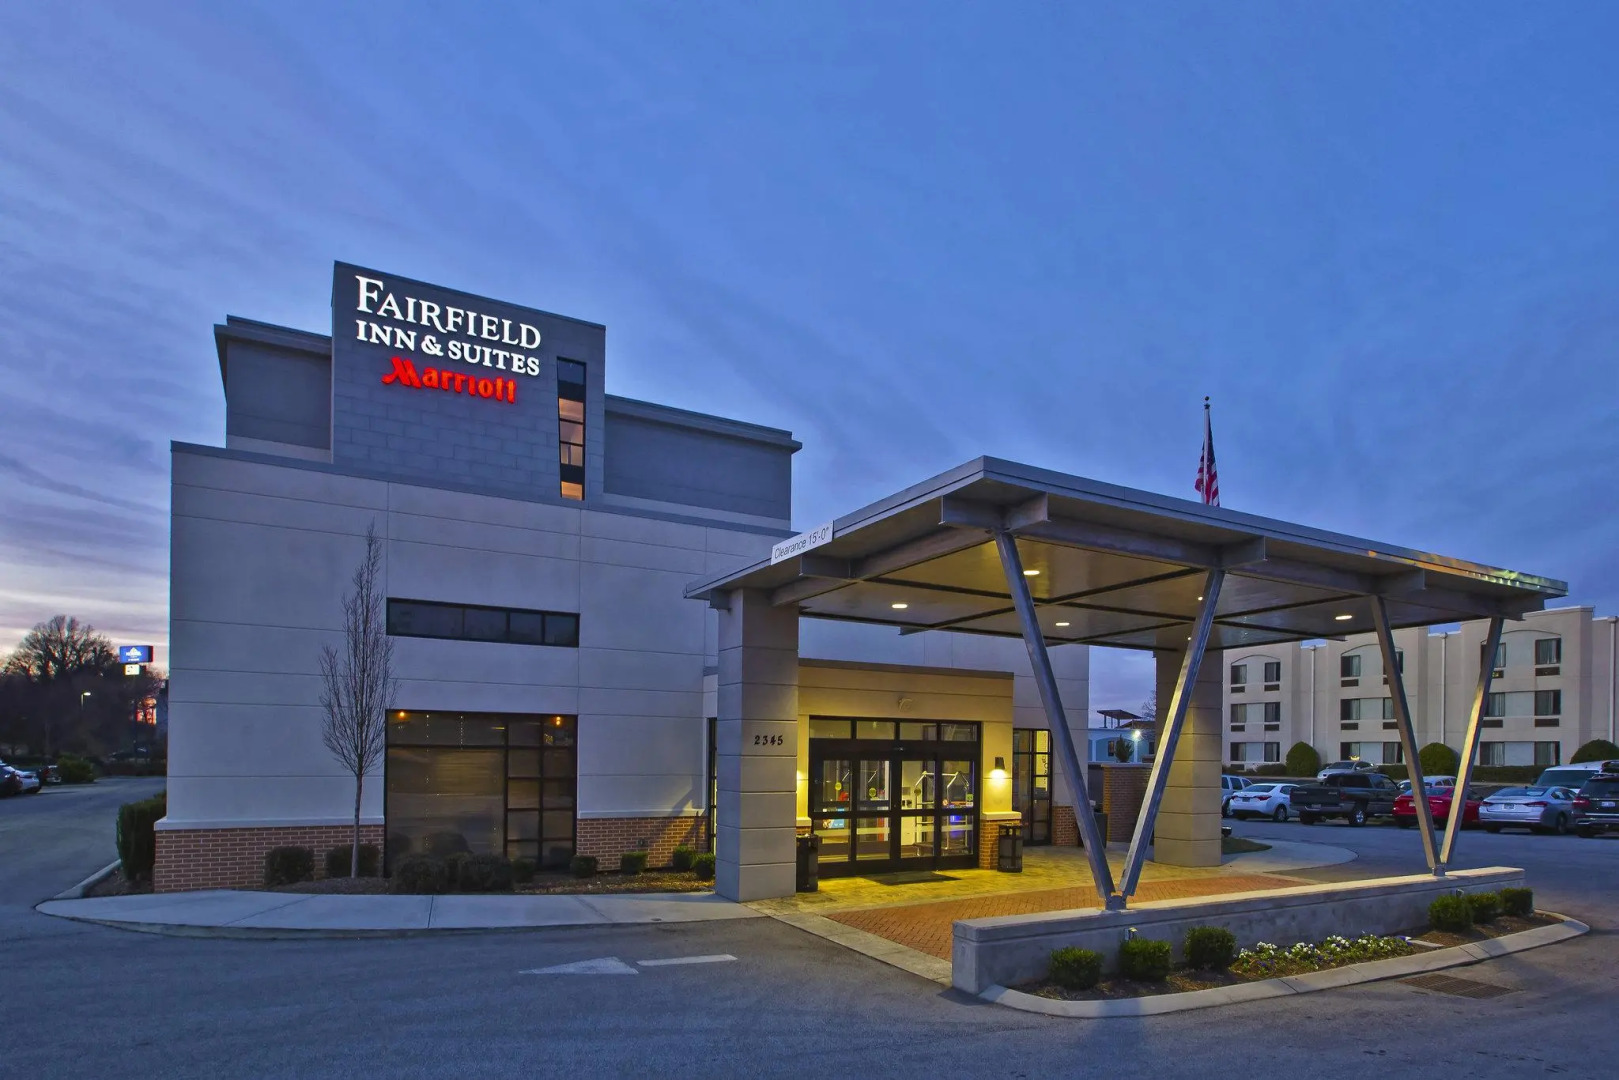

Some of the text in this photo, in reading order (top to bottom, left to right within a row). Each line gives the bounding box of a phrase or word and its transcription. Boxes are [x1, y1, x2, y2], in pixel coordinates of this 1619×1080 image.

[355, 275, 542, 349] FAIRFIELD
[355, 319, 540, 376] INN & SUITES
[381, 355, 518, 404] Marriott
[774, 539, 806, 559] Clearance
[754, 734, 784, 746] 2345
